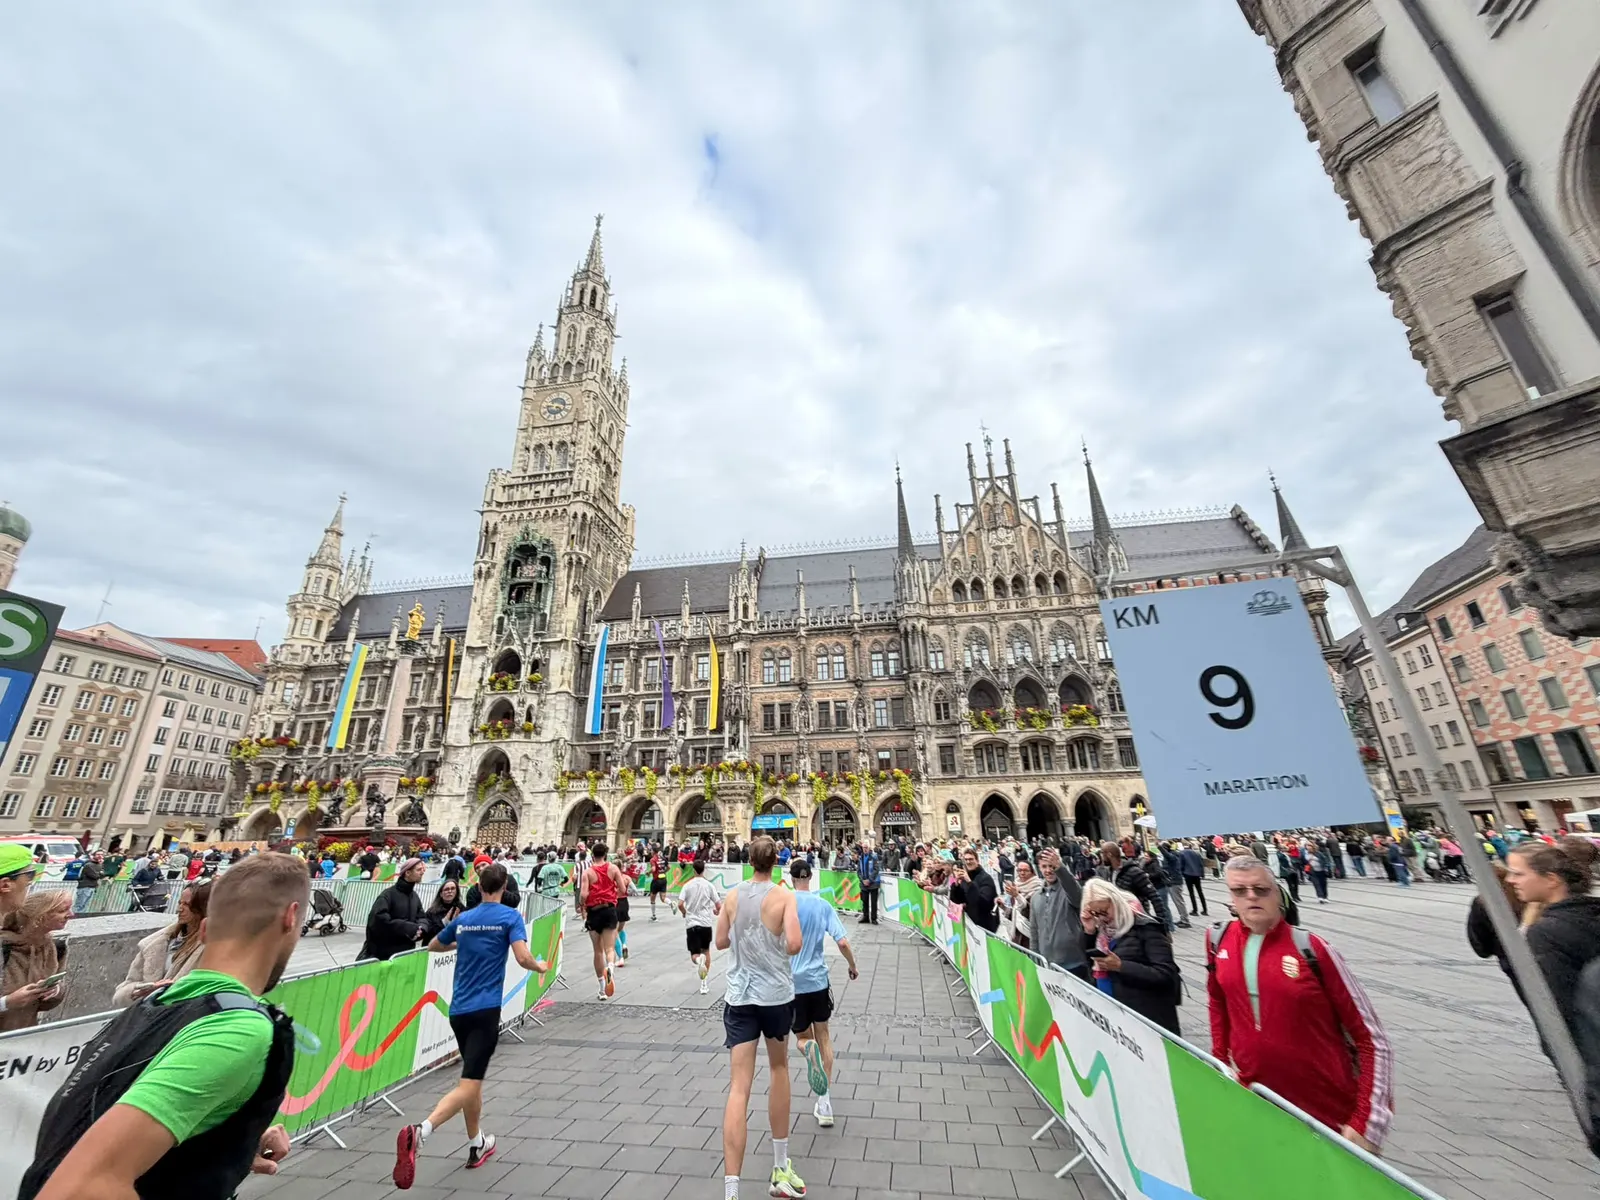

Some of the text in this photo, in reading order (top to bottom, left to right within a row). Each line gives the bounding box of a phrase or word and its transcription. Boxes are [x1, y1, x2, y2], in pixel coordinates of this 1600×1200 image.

[1112, 604, 1160, 629] KM
[1199, 664, 1256, 730] 9
[1203, 774, 1310, 796] MARATHON
[287, 827, 293, 835] U
[289, 818, 295, 826] S
[35, 1057, 61, 1073] by
[61, 1042, 112, 1097] KIPRUN
